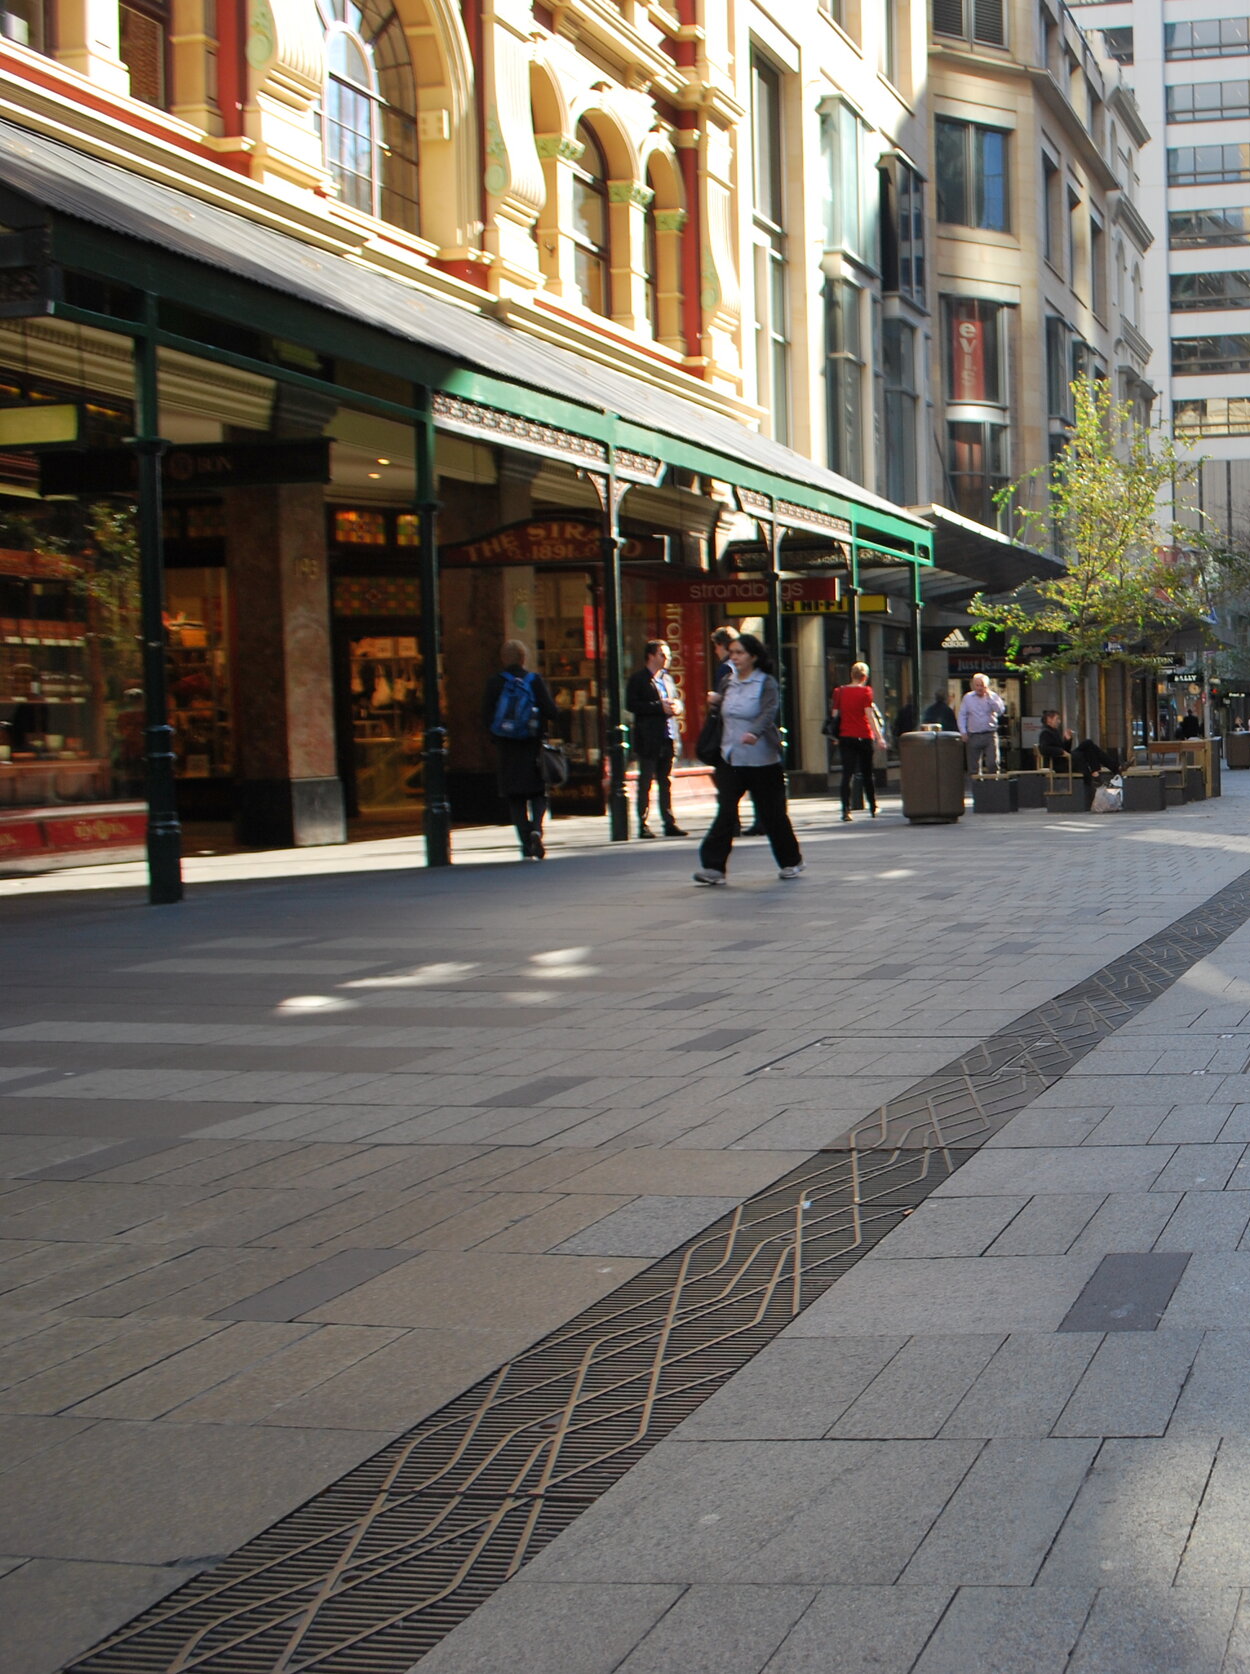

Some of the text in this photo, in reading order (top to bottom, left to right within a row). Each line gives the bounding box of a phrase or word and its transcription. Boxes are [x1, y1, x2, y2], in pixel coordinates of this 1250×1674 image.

[465, 521, 643, 562] THE STRAD
[690, 582, 804, 600] strandbgs
